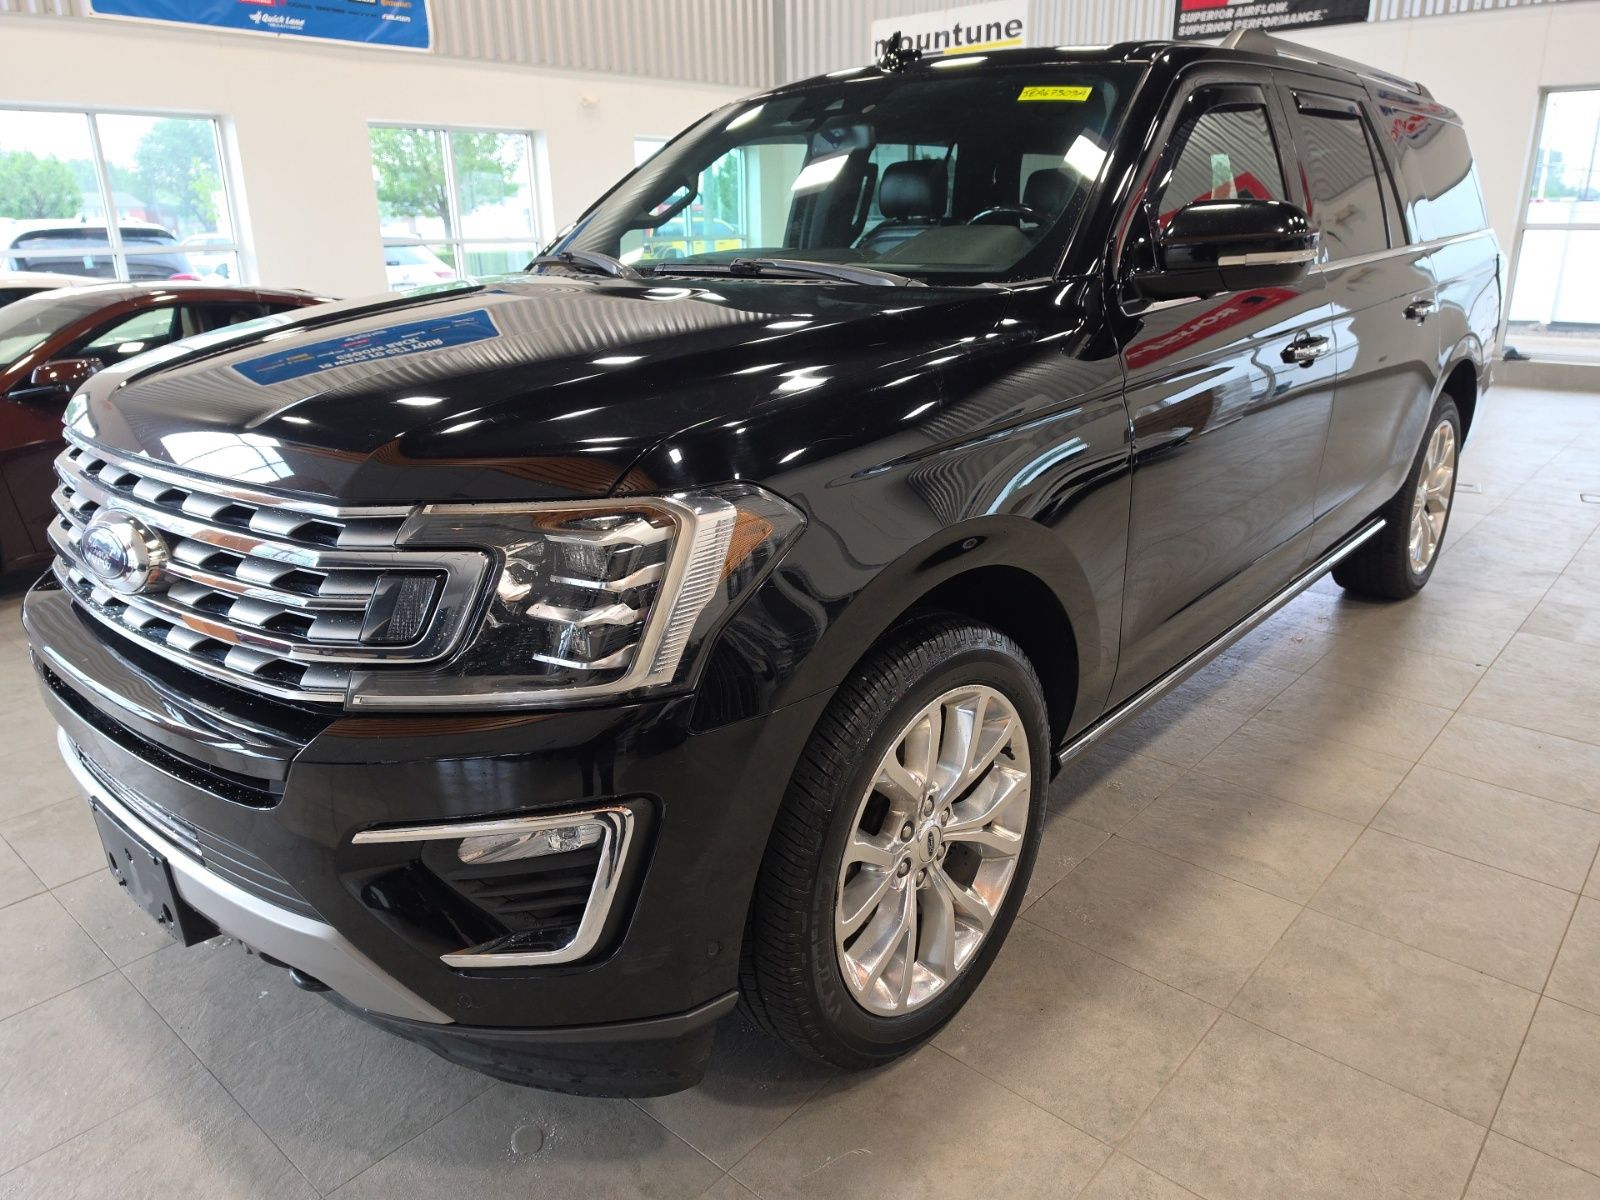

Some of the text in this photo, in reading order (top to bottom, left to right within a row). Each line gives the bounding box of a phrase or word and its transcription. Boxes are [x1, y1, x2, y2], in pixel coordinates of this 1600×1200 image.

[261, 13, 285, 25] Quick
[285, 16, 305, 27] Lane
[1179, 9, 1233, 23] SUPERIOR
[1178, 20, 1233, 36] SUPERIOR
[875, 18, 1023, 57] mountune
